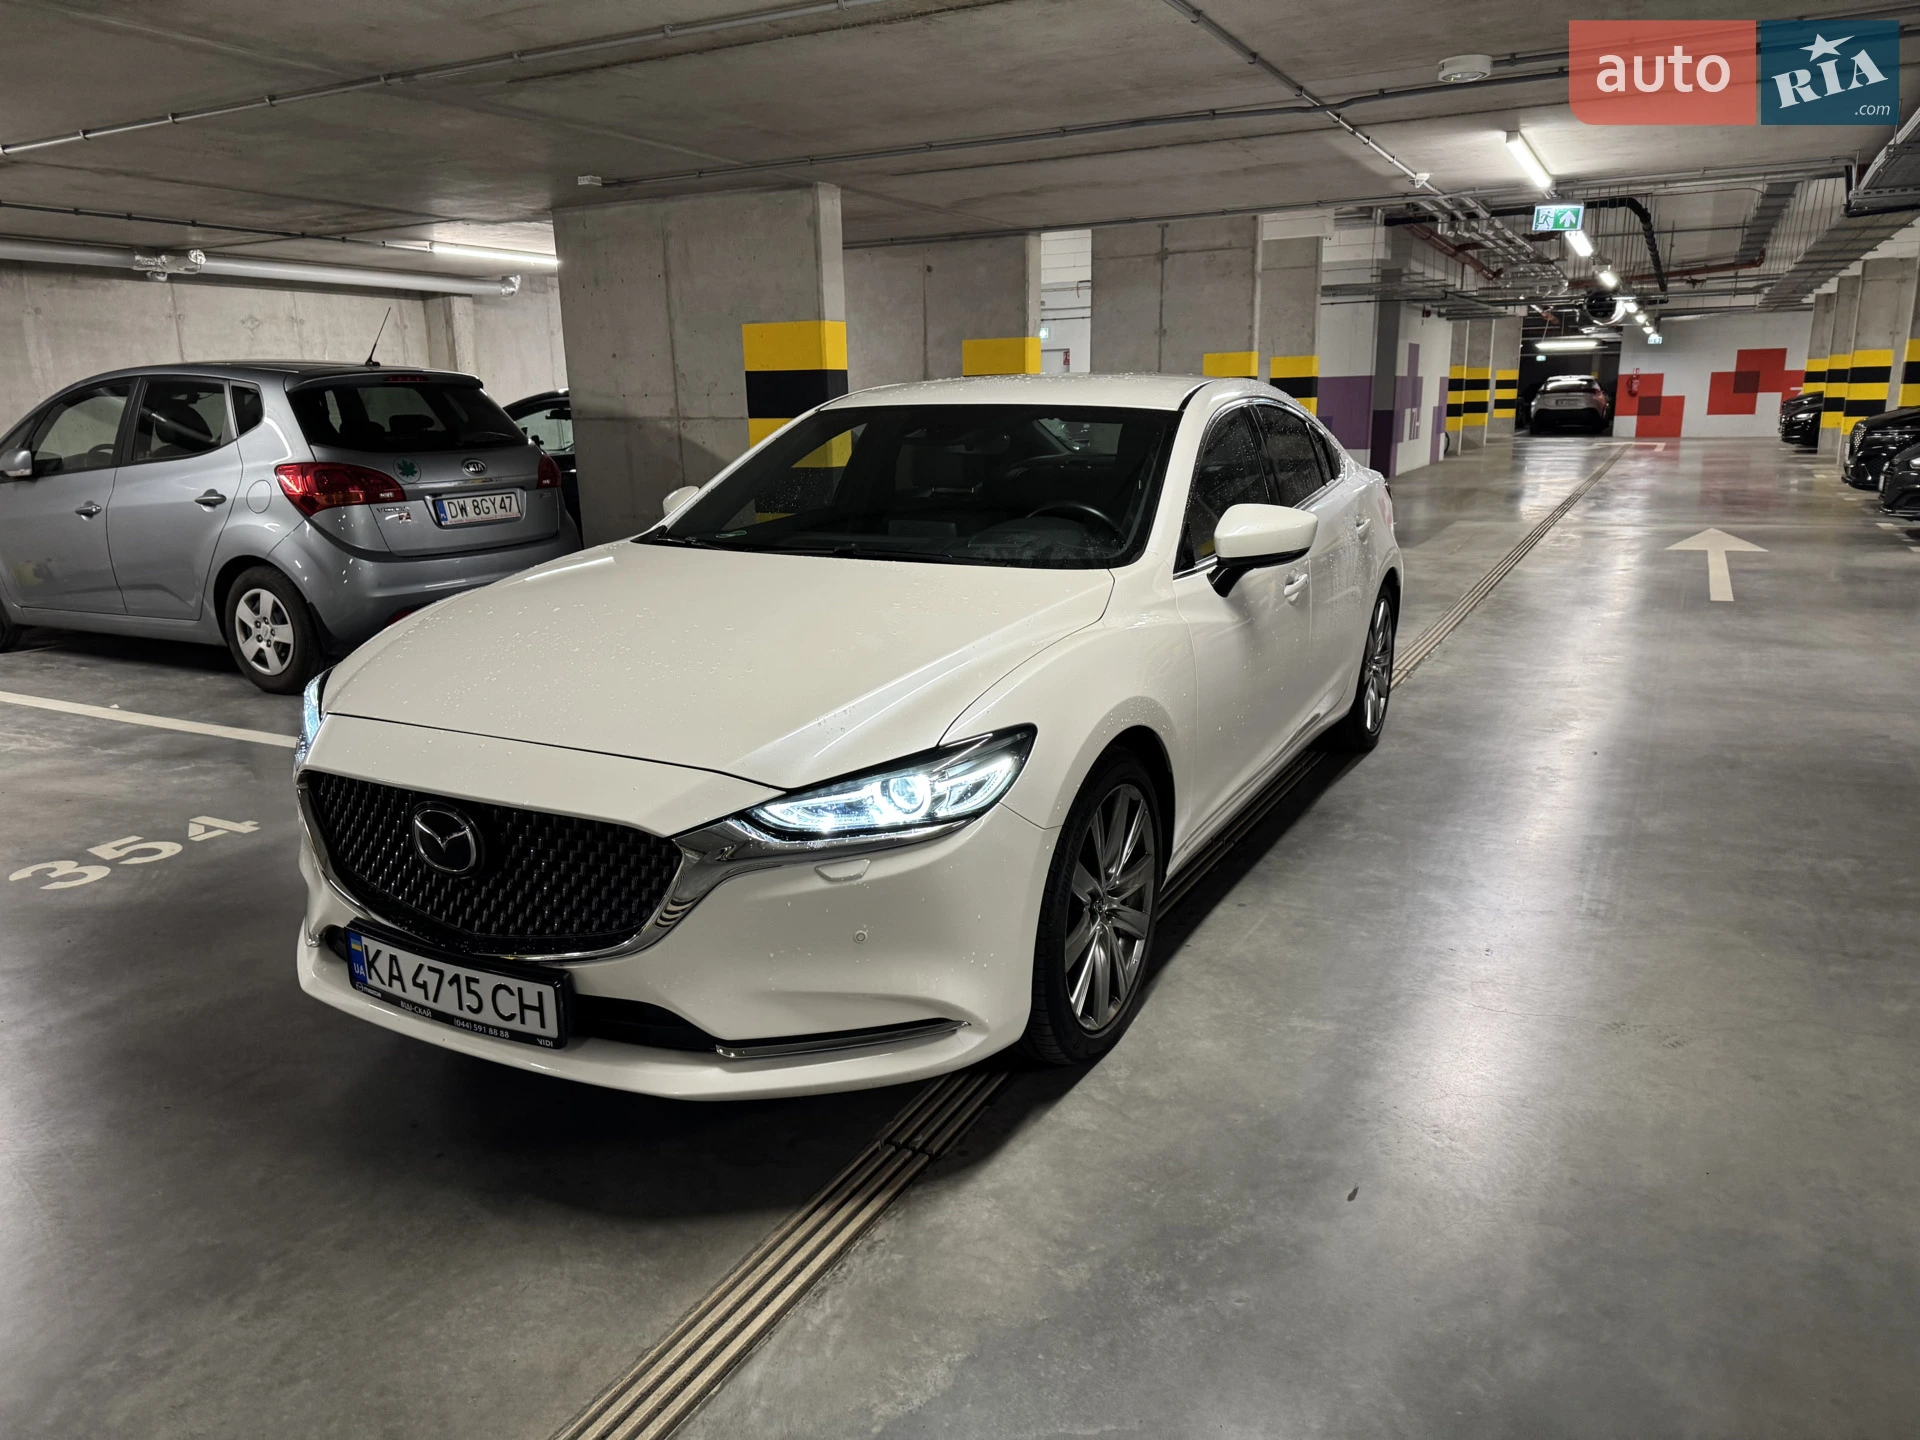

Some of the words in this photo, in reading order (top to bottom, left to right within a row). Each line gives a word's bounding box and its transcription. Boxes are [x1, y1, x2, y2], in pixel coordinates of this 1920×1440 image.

[469, 463, 484, 471] KIA
[447, 500, 469, 519] DW
[474, 496, 513, 515] 8GY47
[8, 815, 261, 890] 354
[353, 962, 366, 977] UA
[364, 944, 406, 993] KA
[412, 963, 483, 1015] 4715
[491, 983, 546, 1029] CH
[454, 1018, 472, 1030] (044)
[474, 1023, 487, 1033] 591
[489, 1028, 498, 1036] 88
